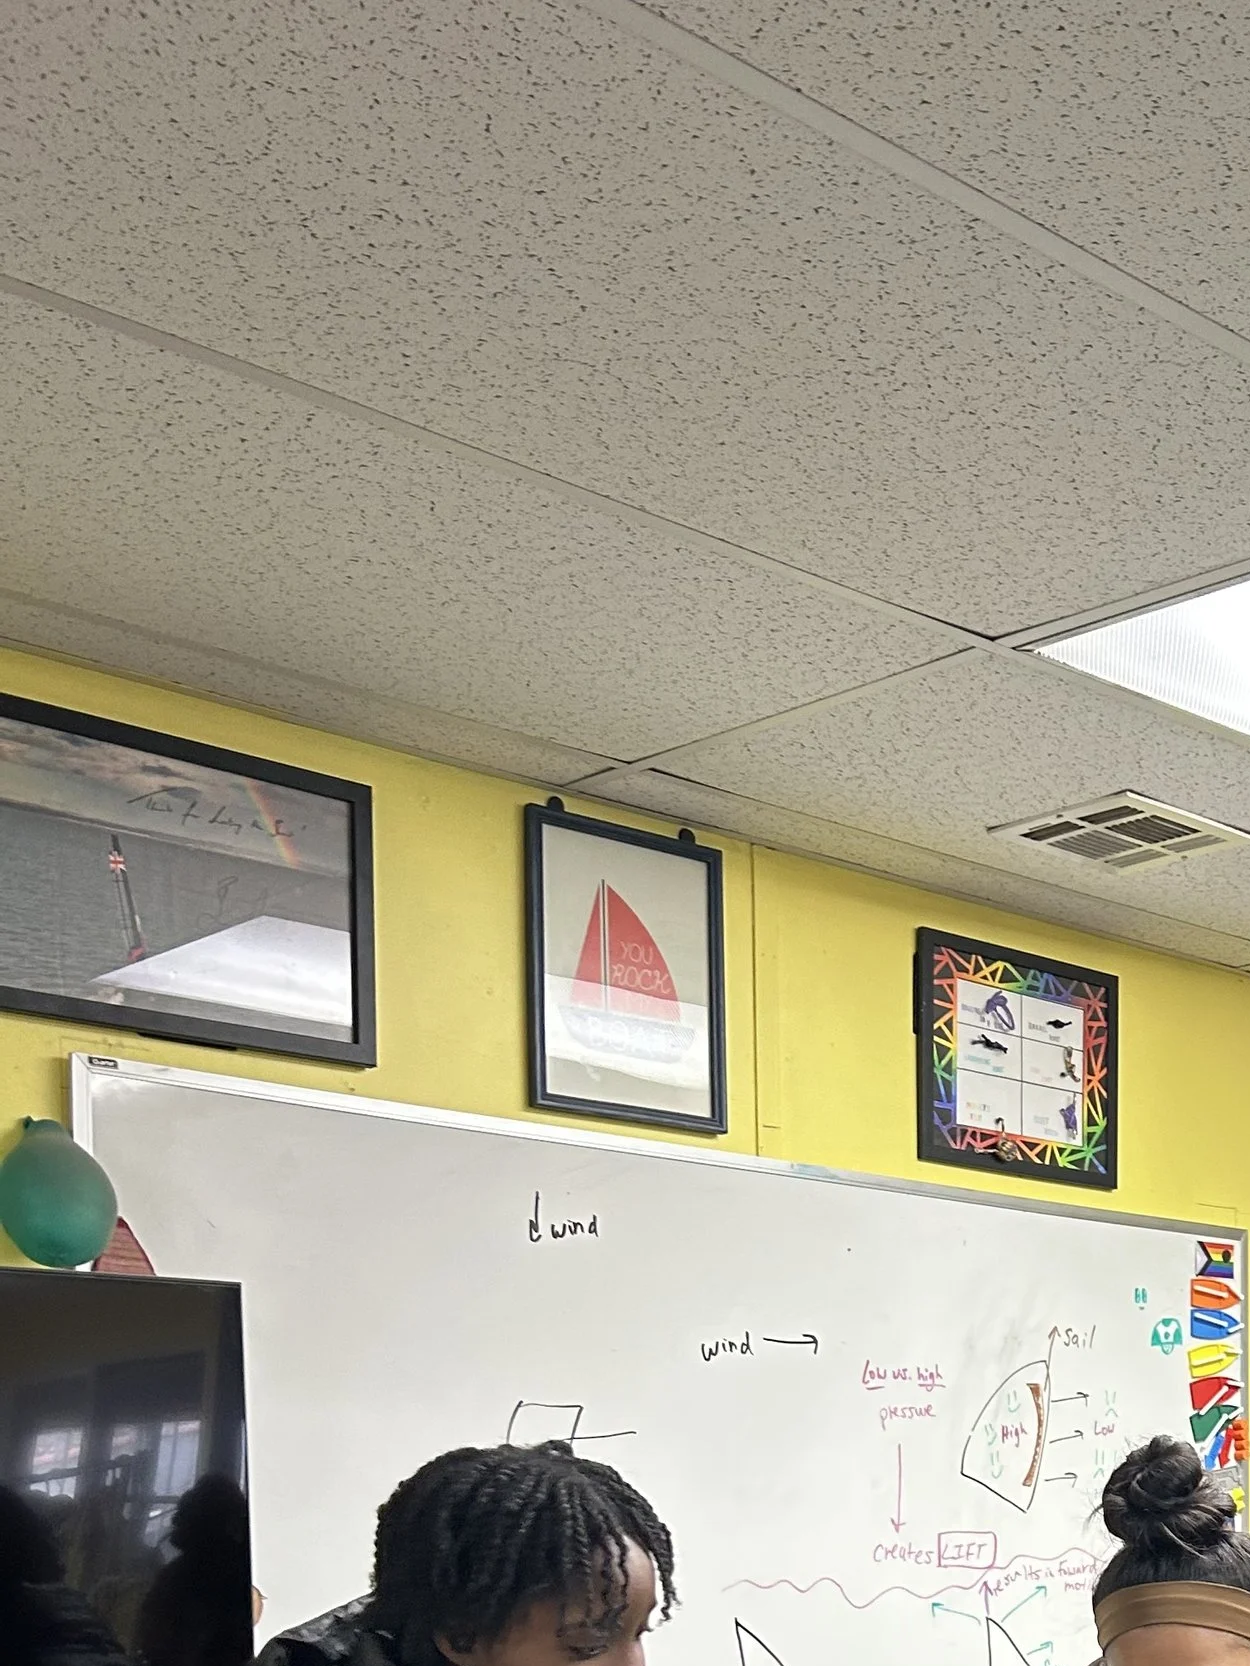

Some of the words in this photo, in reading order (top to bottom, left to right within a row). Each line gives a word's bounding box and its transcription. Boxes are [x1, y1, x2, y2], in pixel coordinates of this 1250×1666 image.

[619, 941, 654, 964] YOU
[611, 963, 672, 994] ROCK
[550, 1214, 599, 1239] wind
[701, 1331, 755, 1361] wind
[861, 1359, 887, 1385] Low
[917, 1364, 943, 1391] high
[879, 1403, 937, 1431] pressure
[1001, 1422, 1028, 1448] High
[940, 1543, 988, 1561] LIFT
